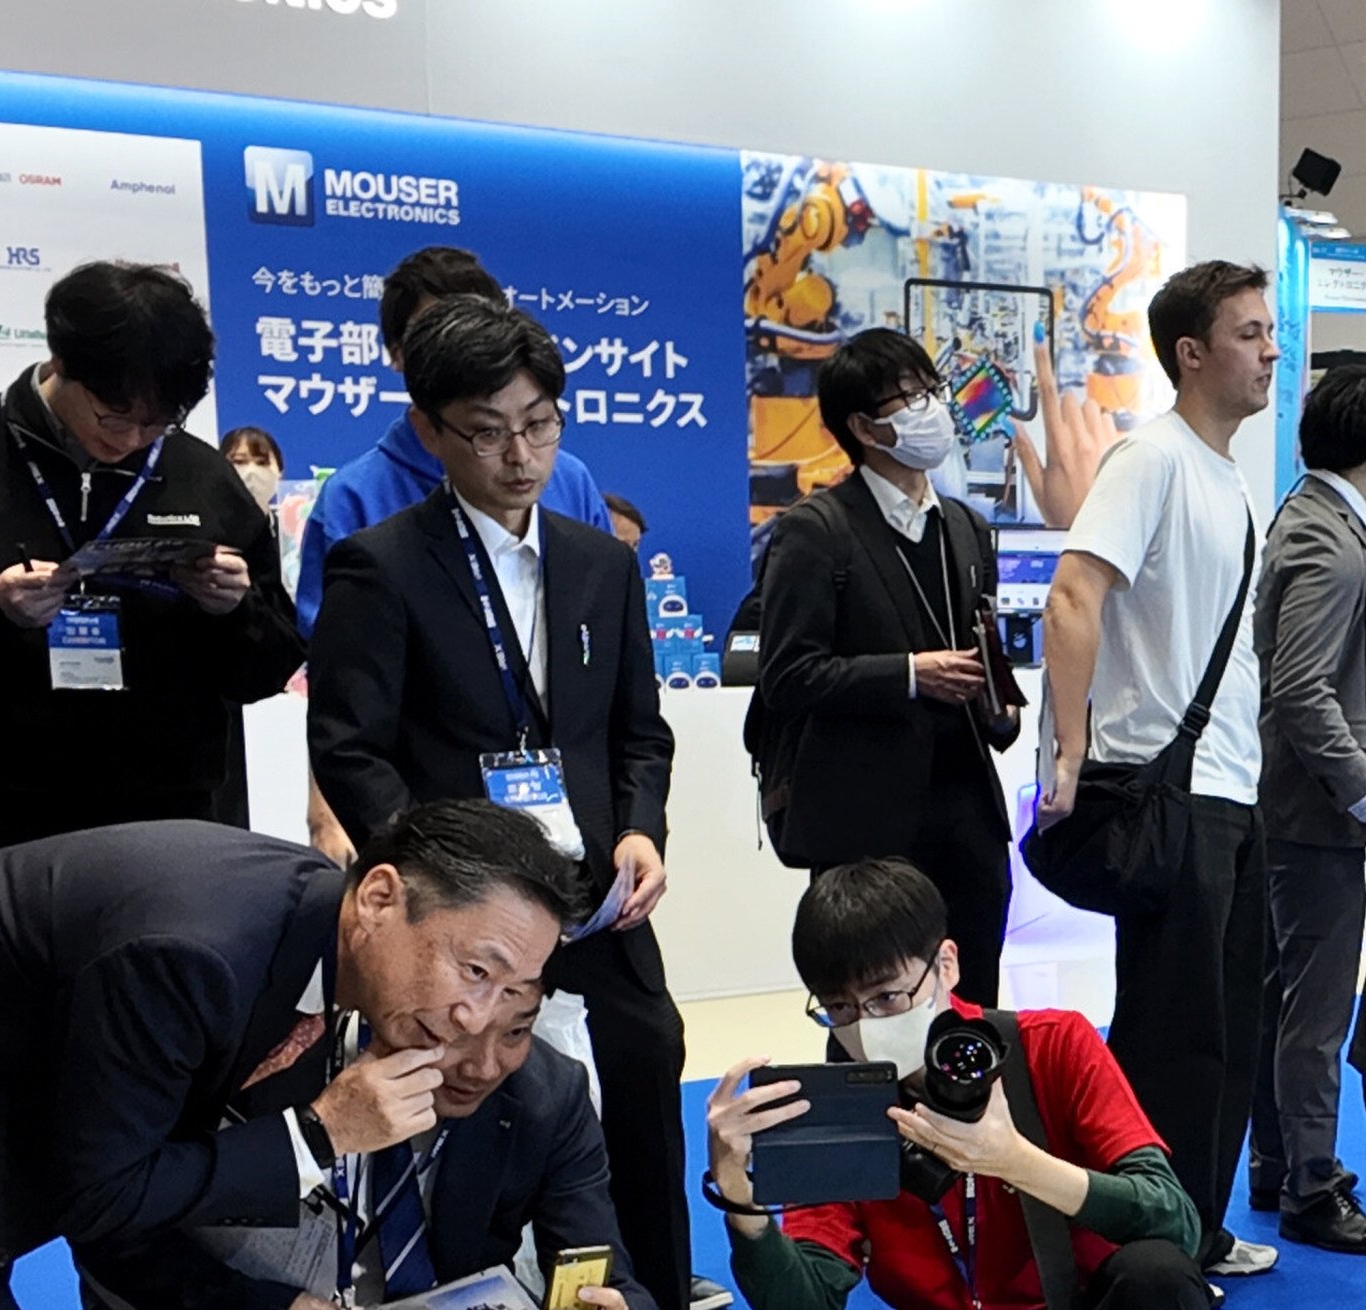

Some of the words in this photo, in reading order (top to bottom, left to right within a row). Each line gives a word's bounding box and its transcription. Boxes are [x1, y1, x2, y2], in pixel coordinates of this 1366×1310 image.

[111, 179, 176, 195] Amphenol
[324, 168, 458, 206] MOUSER
[325, 199, 461, 226] ELECTRONICS
[7, 247, 40, 266] HRS
[550, 334, 688, 378] ンサイト
